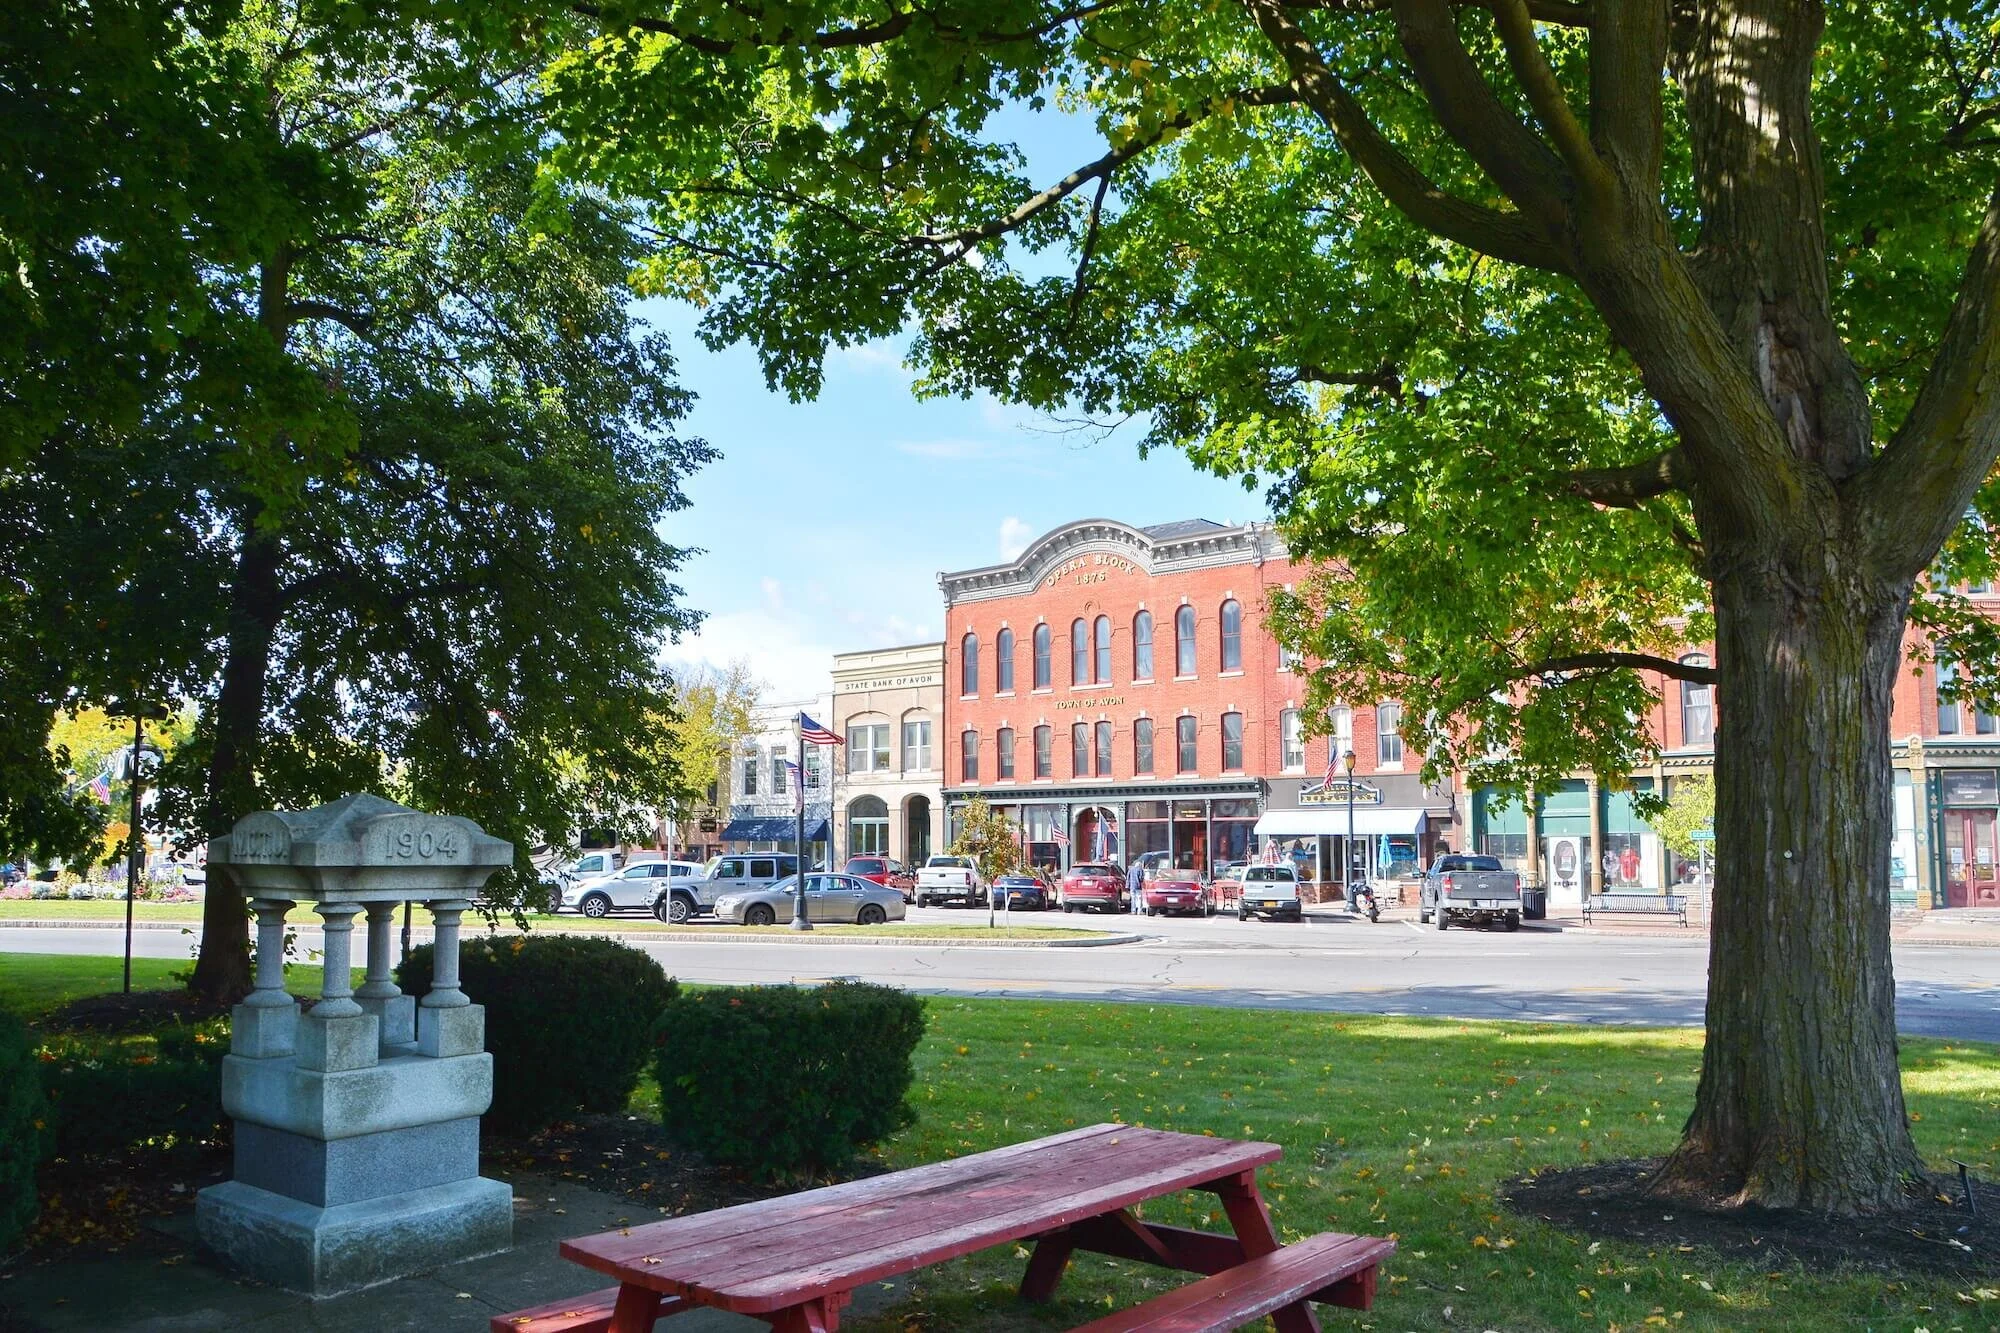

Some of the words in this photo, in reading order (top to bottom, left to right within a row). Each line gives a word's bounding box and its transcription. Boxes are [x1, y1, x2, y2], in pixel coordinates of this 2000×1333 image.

[1047, 558, 1087, 586] OPERA
[1095, 554, 1136, 575] BLOCK
[1075, 572, 1106, 585] 1876
[845, 682, 868, 690] STATE
[910, 675, 932, 684] AVON
[1055, 700, 1082, 709] TOWN
[1084, 698, 1097, 707] OF
[1100, 697, 1124, 706] AVON
[385, 830, 457, 859] 1904
